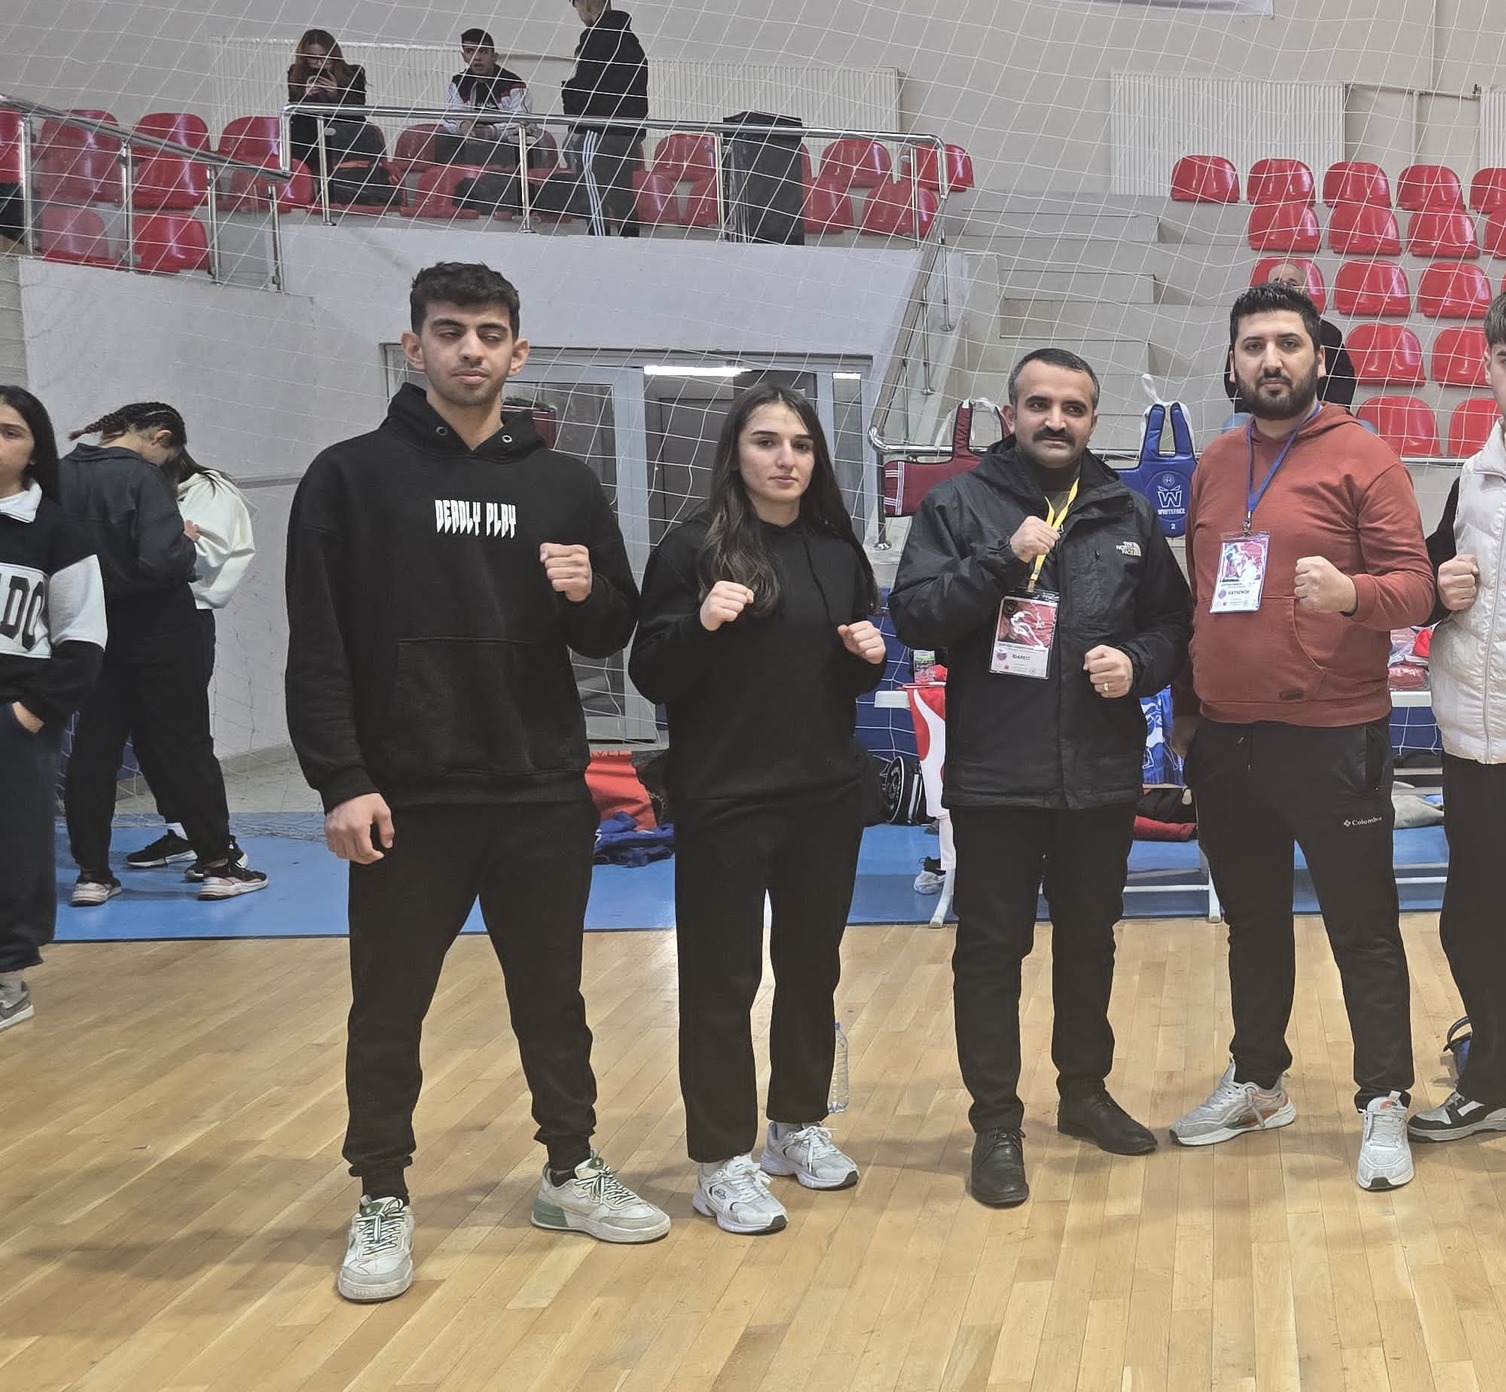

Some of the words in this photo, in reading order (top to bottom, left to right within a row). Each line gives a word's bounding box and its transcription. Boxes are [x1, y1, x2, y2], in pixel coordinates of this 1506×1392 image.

[435, 499, 481, 537] DEADLY
[486, 502, 517, 539] PLAY
[0, 573, 45, 653] DO
